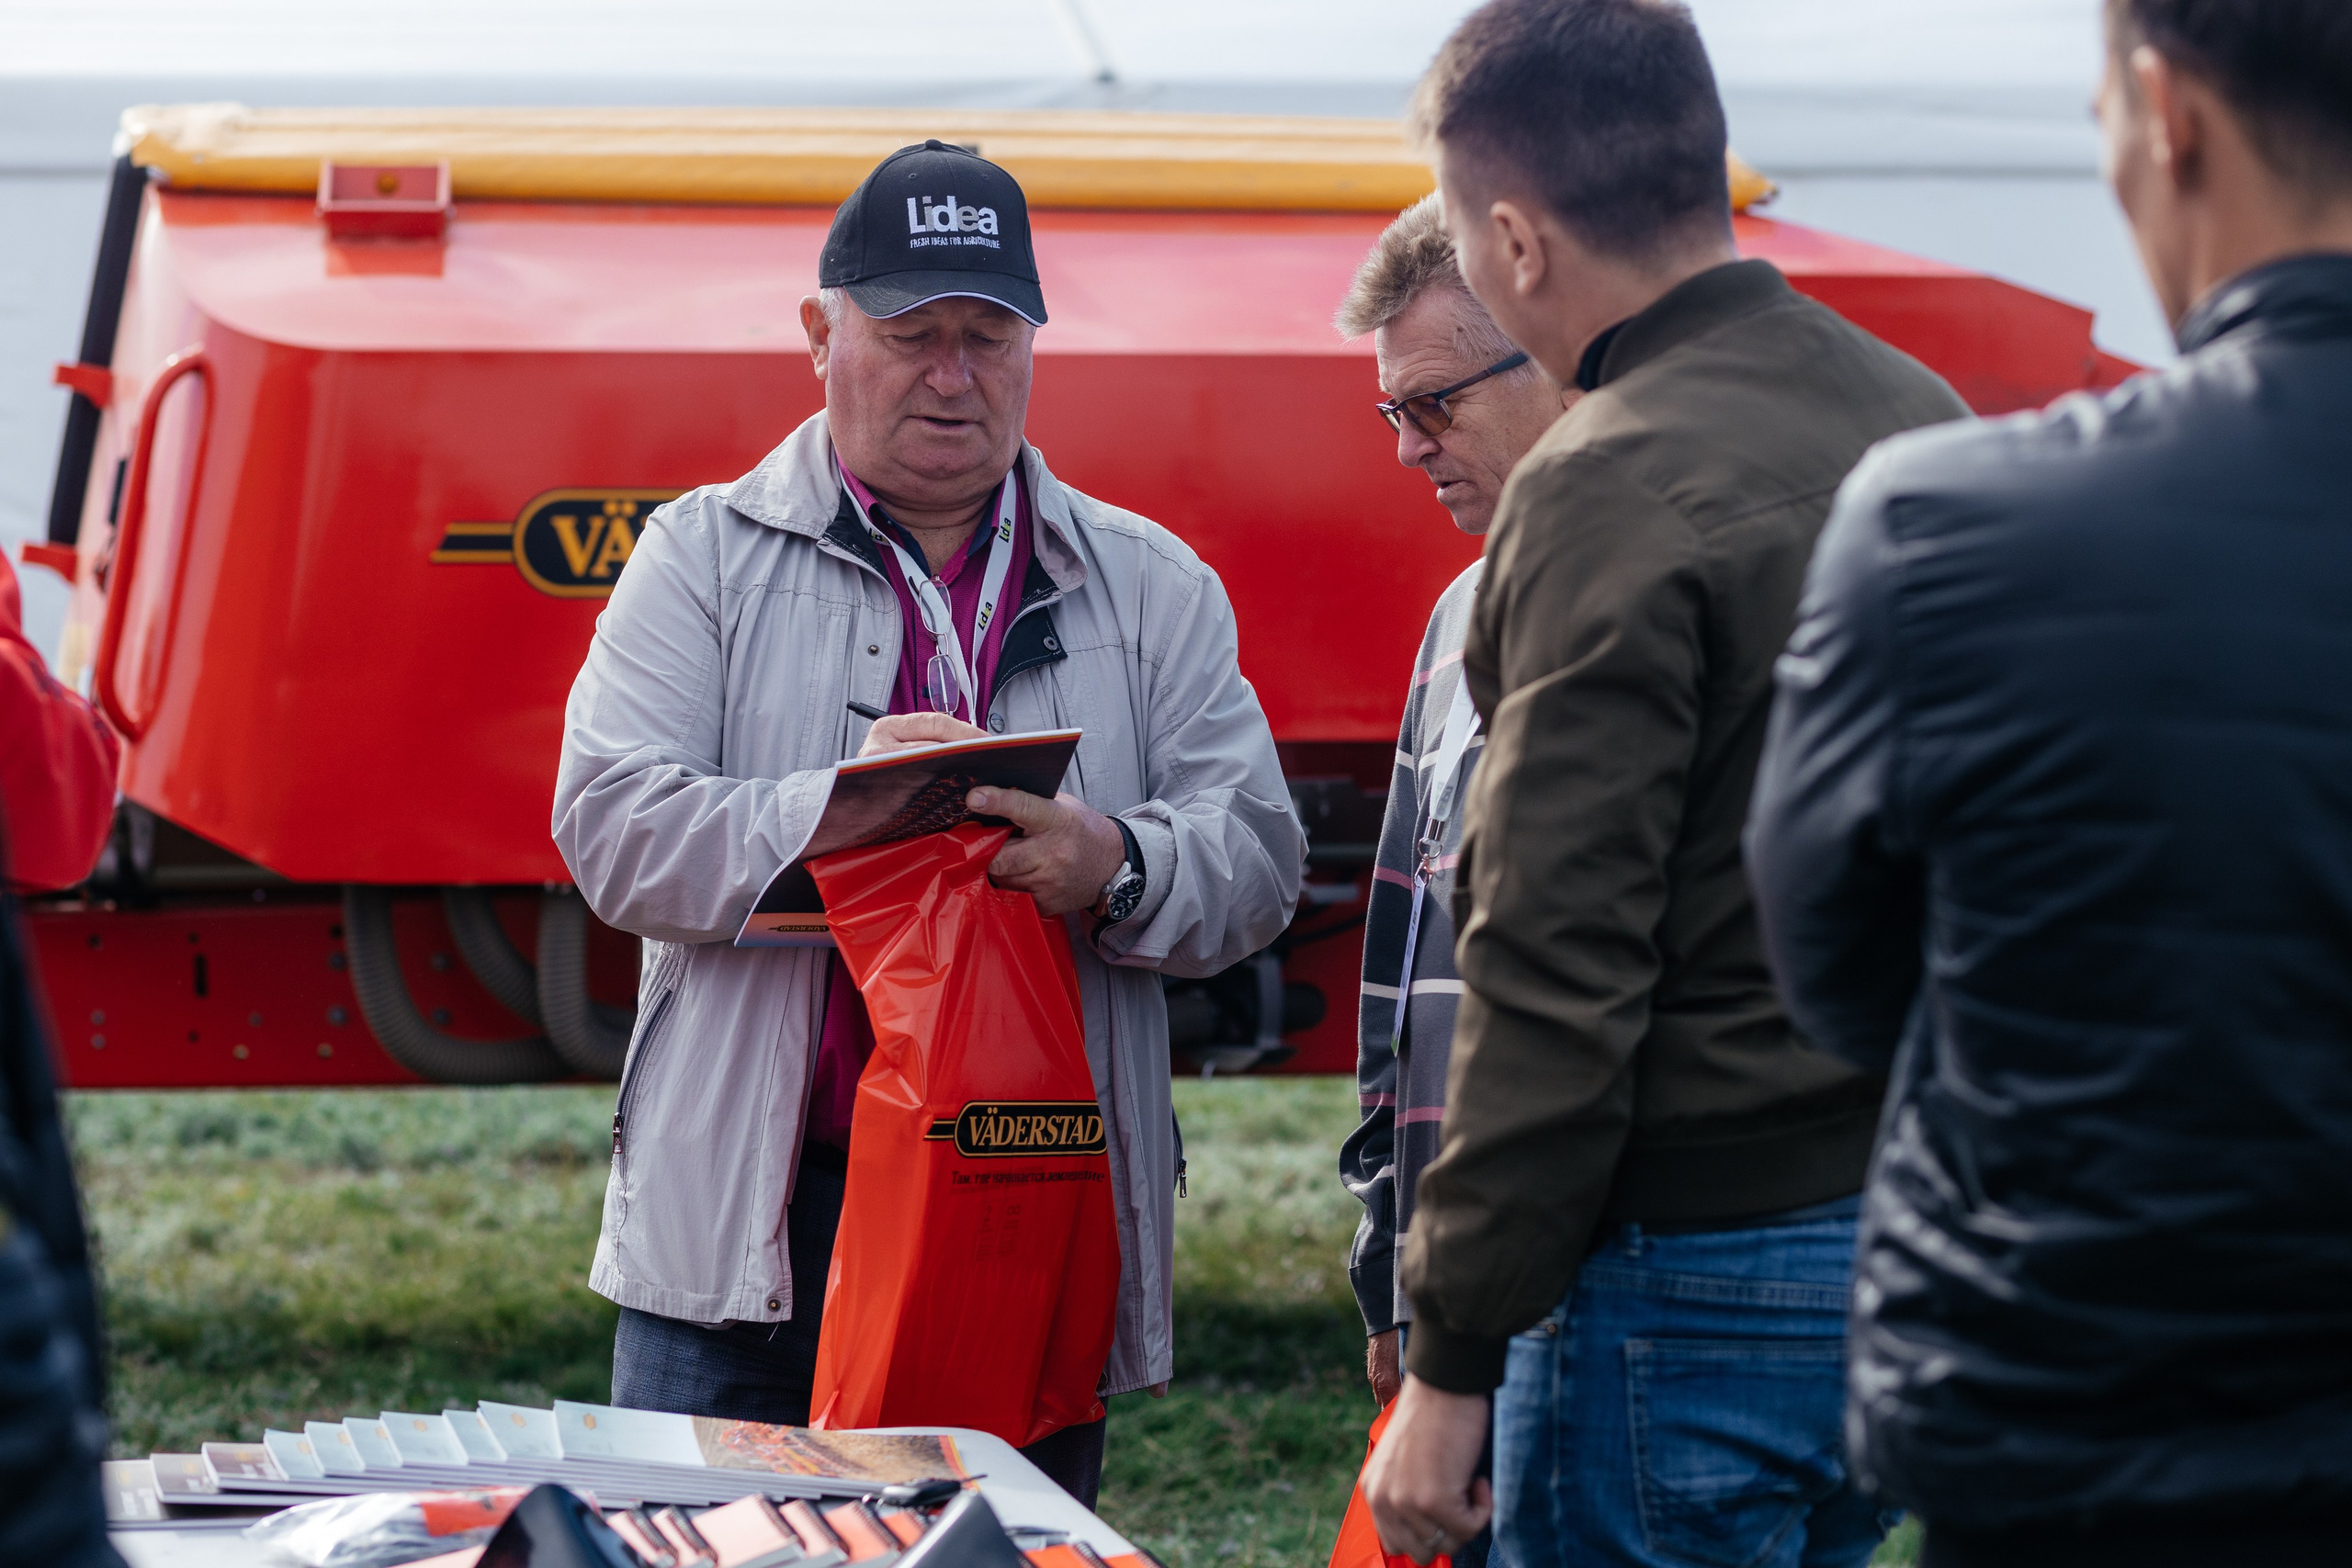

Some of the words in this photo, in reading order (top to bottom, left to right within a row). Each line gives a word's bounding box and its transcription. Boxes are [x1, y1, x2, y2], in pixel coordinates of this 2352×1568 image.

[907, 196, 999, 234] Lidea
[910, 237, 930, 249] FRESH
[931, 237, 948, 246] IDEAS
[949, 236, 962, 245] FOR
[963, 236, 1001, 249] AGRICULTURE
[551, 501, 645, 577] VÄ
[968, 1107, 1103, 1146] VÄDERSTAD
